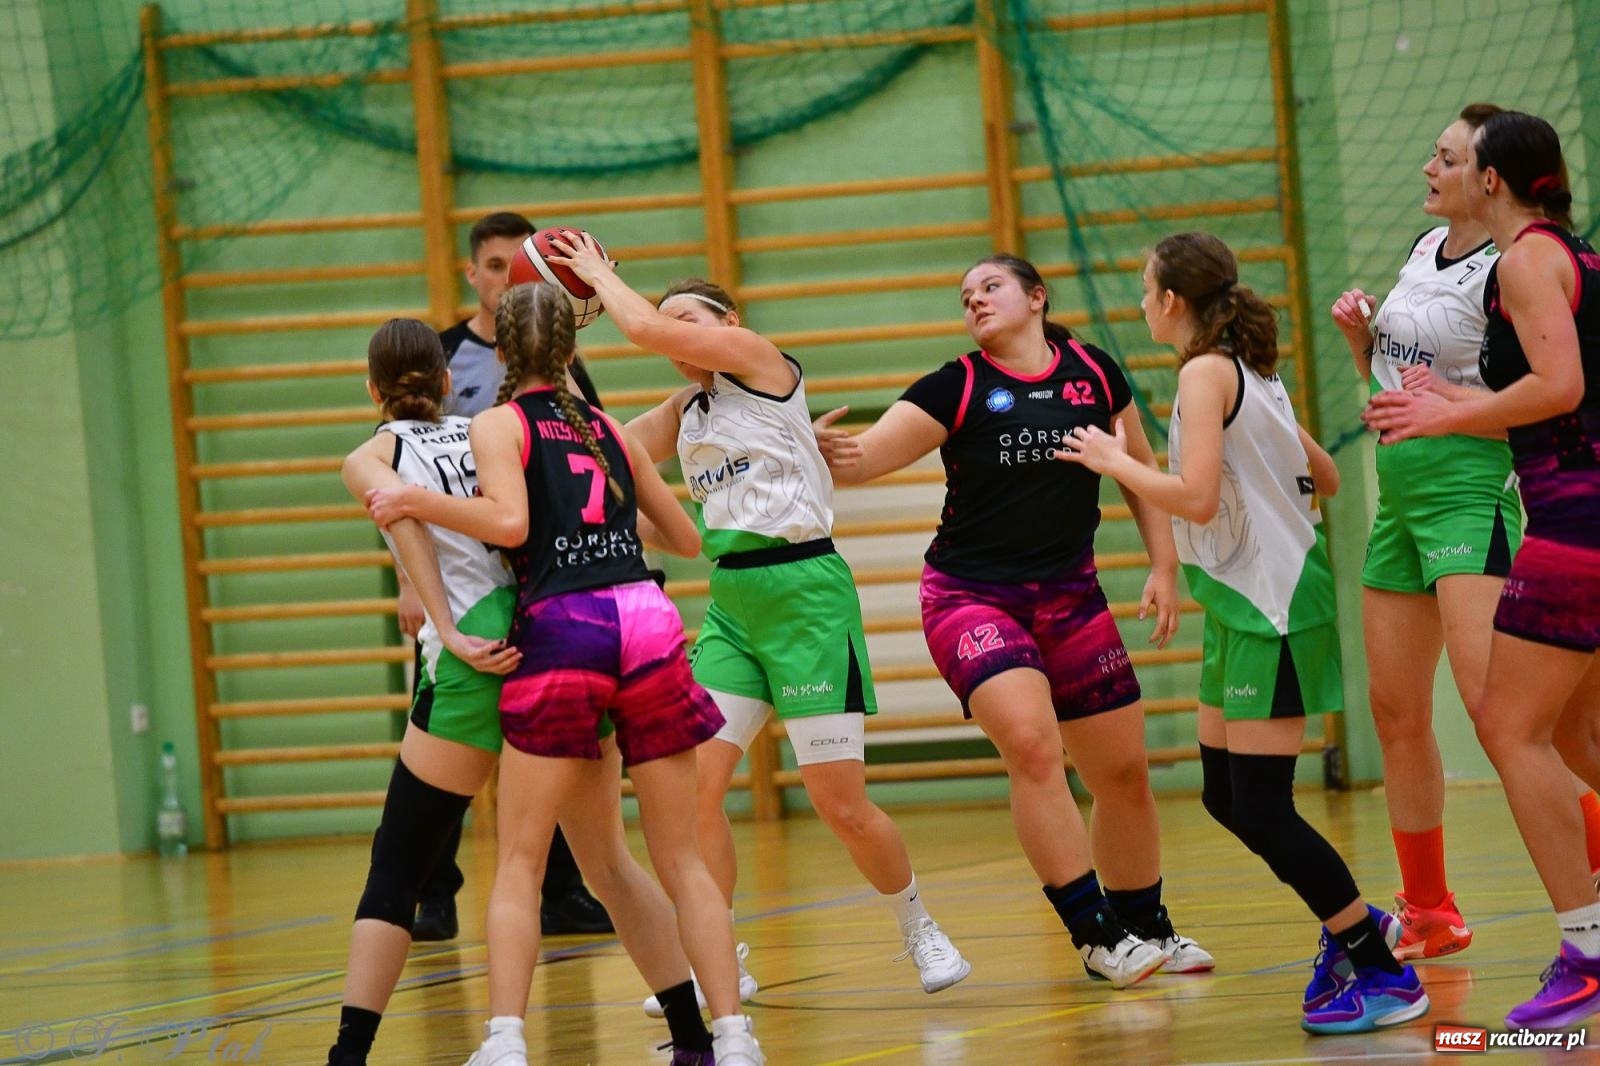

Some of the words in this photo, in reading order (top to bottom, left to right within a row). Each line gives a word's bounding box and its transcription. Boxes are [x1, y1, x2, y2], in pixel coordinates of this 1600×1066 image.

[1457, 261, 1483, 285] 7
[1378, 331, 1435, 369] Clavis
[1062, 381, 1096, 406] 42
[999, 427, 1073, 447] GÓRSK
[566, 453, 607, 524] 7
[697, 456, 750, 494] Clvis
[555, 529, 634, 550] GÓRSK
[957, 622, 1005, 661] 42
